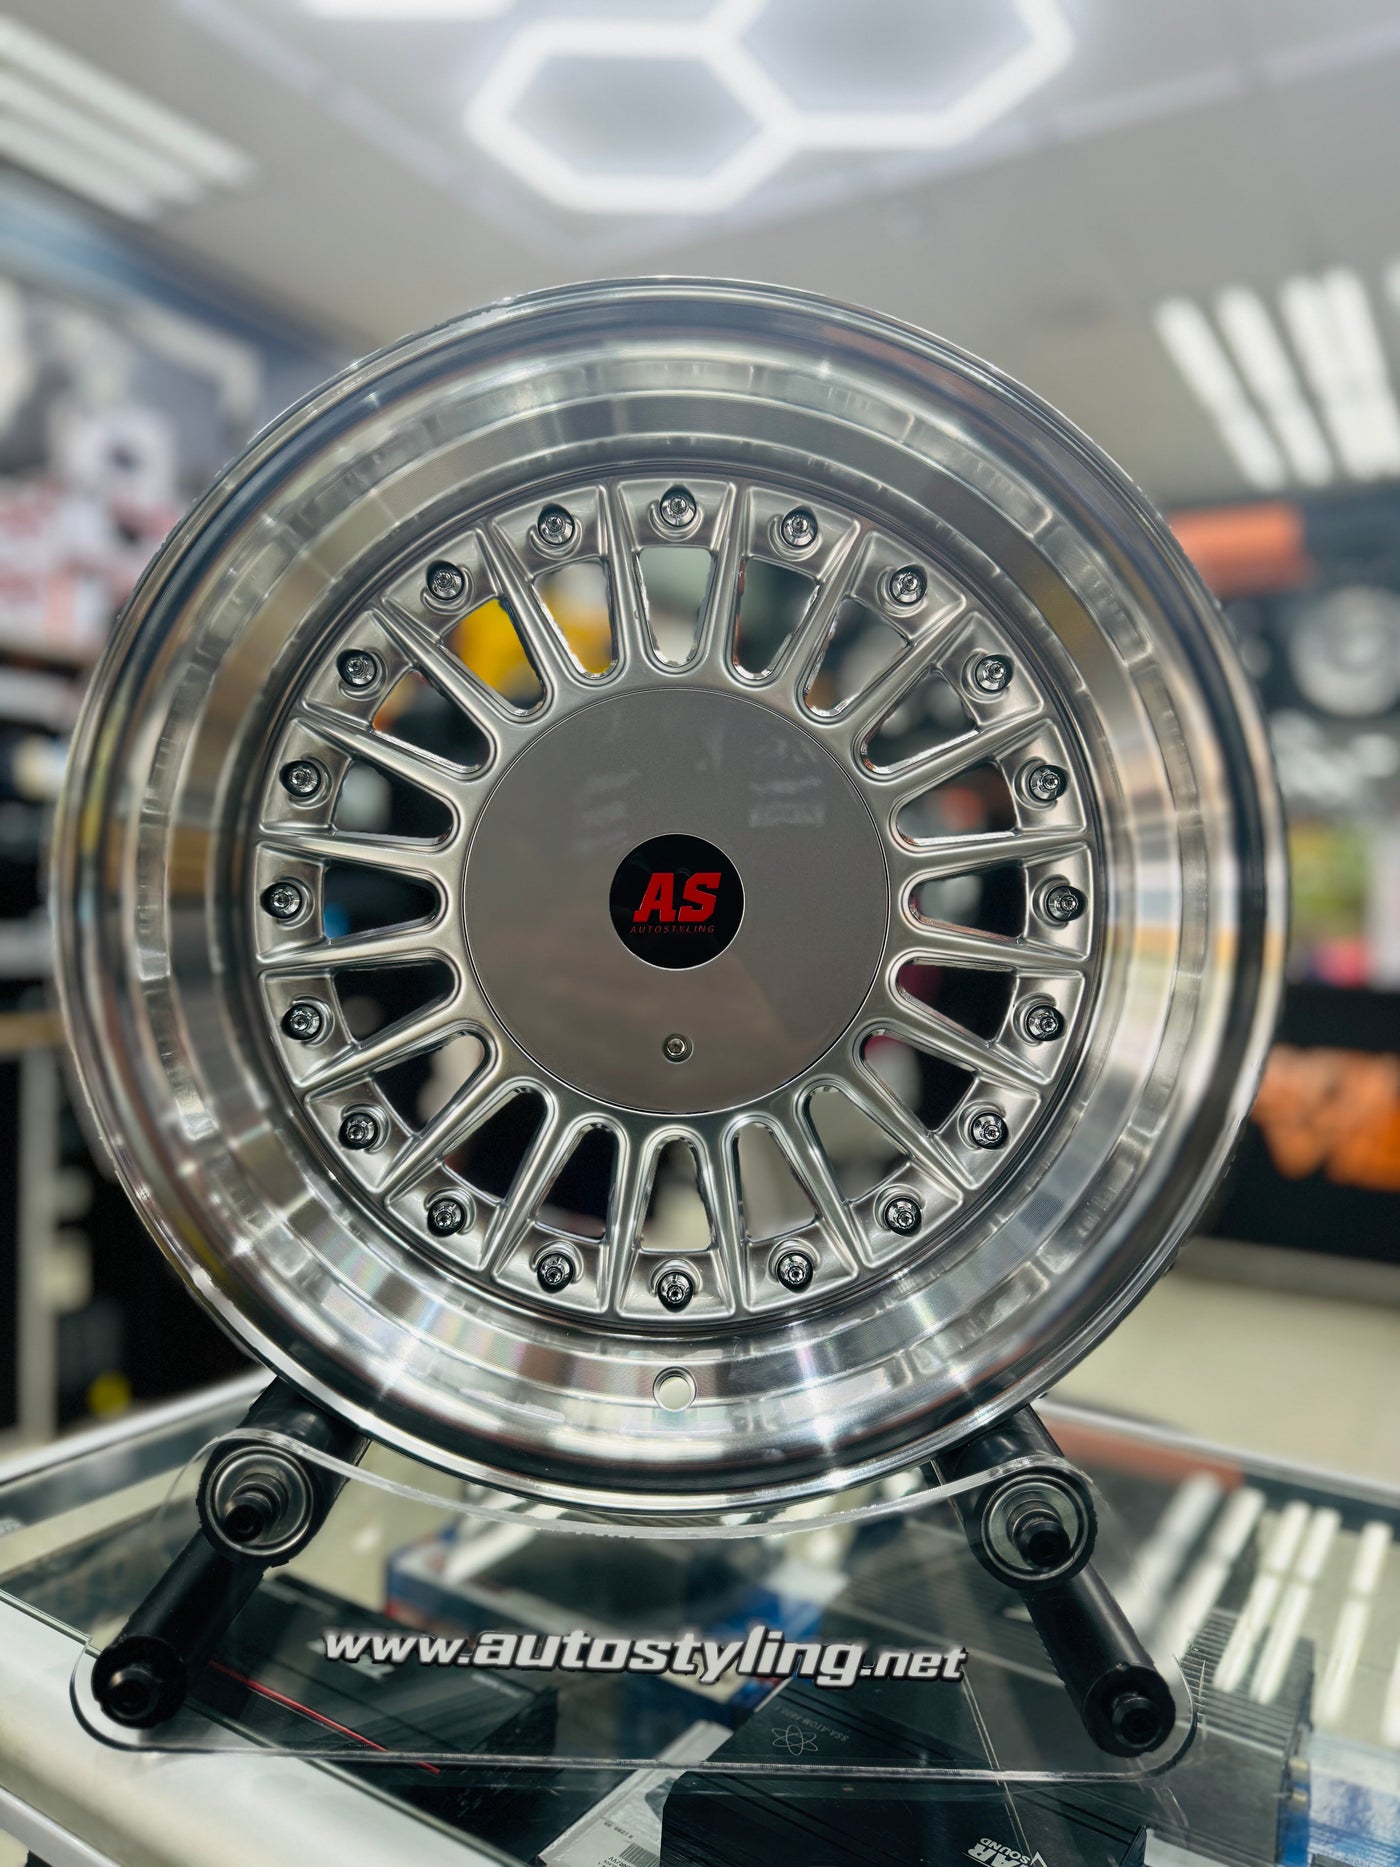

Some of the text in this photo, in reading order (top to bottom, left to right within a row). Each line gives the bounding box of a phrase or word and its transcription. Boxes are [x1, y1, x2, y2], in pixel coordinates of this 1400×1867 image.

[633, 872, 721, 922] AS
[630, 925, 715, 934] AUTOSTYLING
[326, 1625, 967, 1688] www.autostyling.net
[980, 1837, 1031, 1864] SOUND
